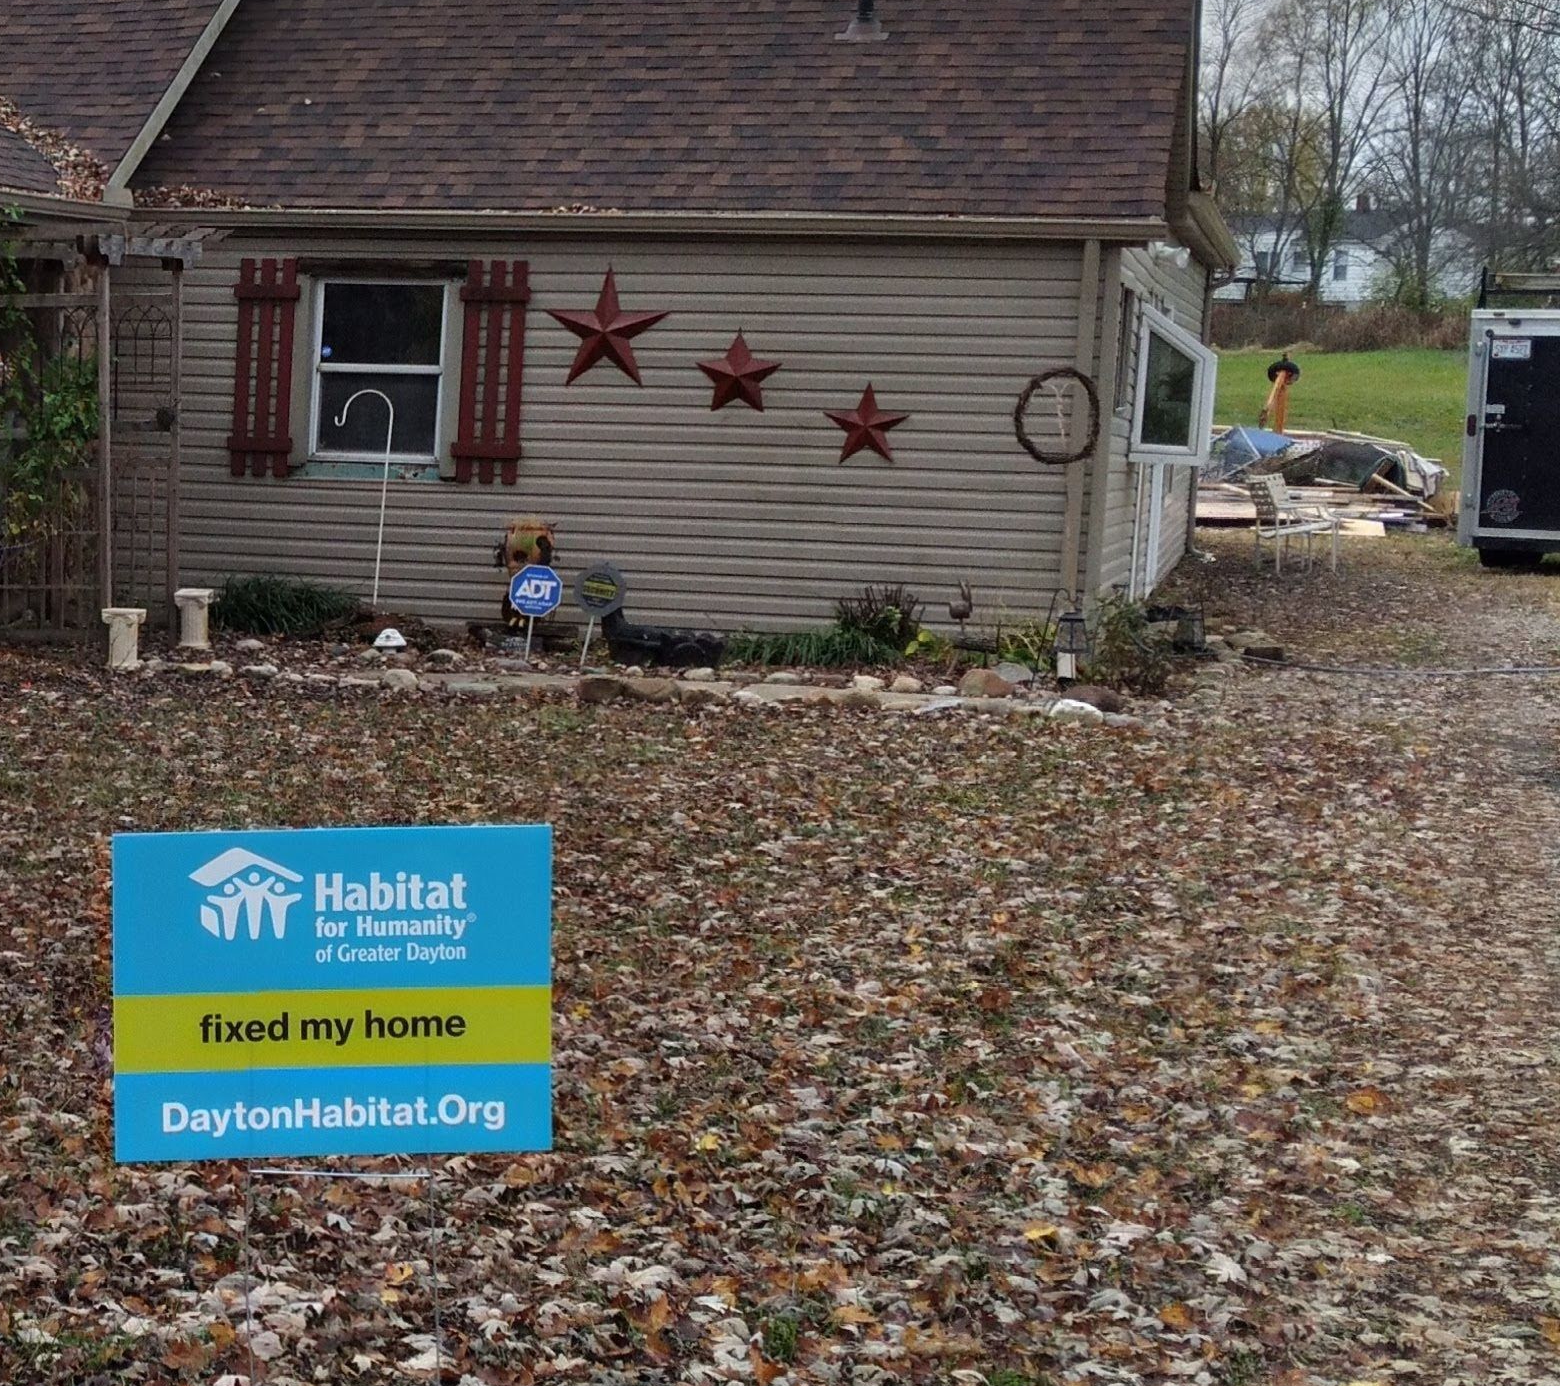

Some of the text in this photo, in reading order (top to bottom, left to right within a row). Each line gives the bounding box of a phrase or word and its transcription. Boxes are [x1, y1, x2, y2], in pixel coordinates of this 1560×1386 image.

[515, 580, 557, 600] ADT
[315, 872, 467, 911] Habitat
[315, 914, 467, 940] for Humanity
[315, 942, 467, 964] of Greater Dayton
[200, 1009, 466, 1046] fixed my home
[162, 1094, 506, 1138] DaytonHabitat.Org
